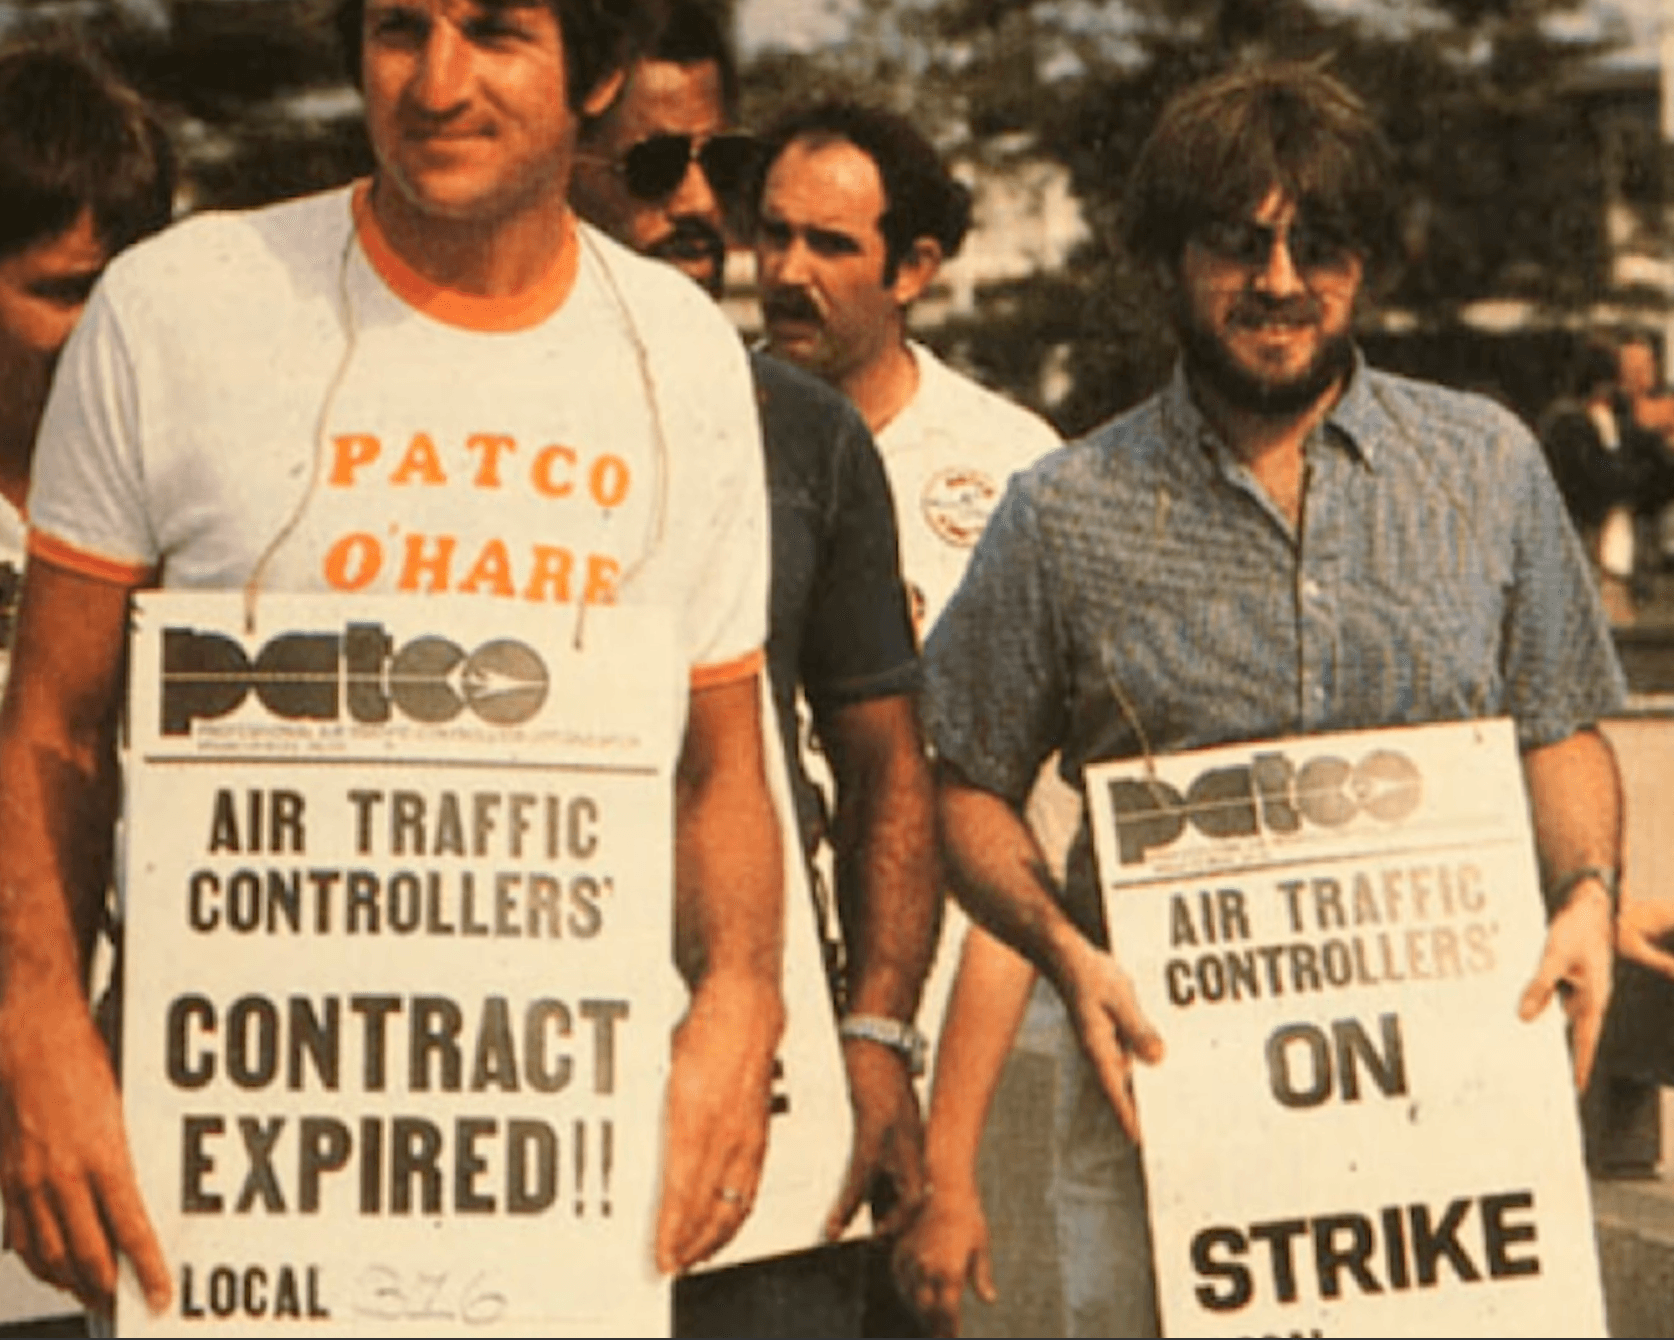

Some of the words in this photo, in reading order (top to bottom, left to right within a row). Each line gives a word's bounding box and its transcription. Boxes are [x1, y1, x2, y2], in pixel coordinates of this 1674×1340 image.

[327, 431, 632, 509] PATCO
[323, 522, 621, 606] O'HARE
[209, 788, 307, 855] AIR
[347, 789, 600, 860] TRAFFIC
[188, 869, 614, 939] CONTROLLERS'
[1169, 888, 1251, 948] AIR
[1278, 863, 1487, 932] TRAFFIC
[1165, 923, 1500, 1006] CONTROLLERS'
[166, 993, 630, 1095] CONTRACT
[1266, 1014, 1407, 1109] ON
[180, 1114, 613, 1218] EXPIRED!!
[180, 1266, 330, 1321] LOCAL
[1189, 1191, 1540, 1312] STRIKE
